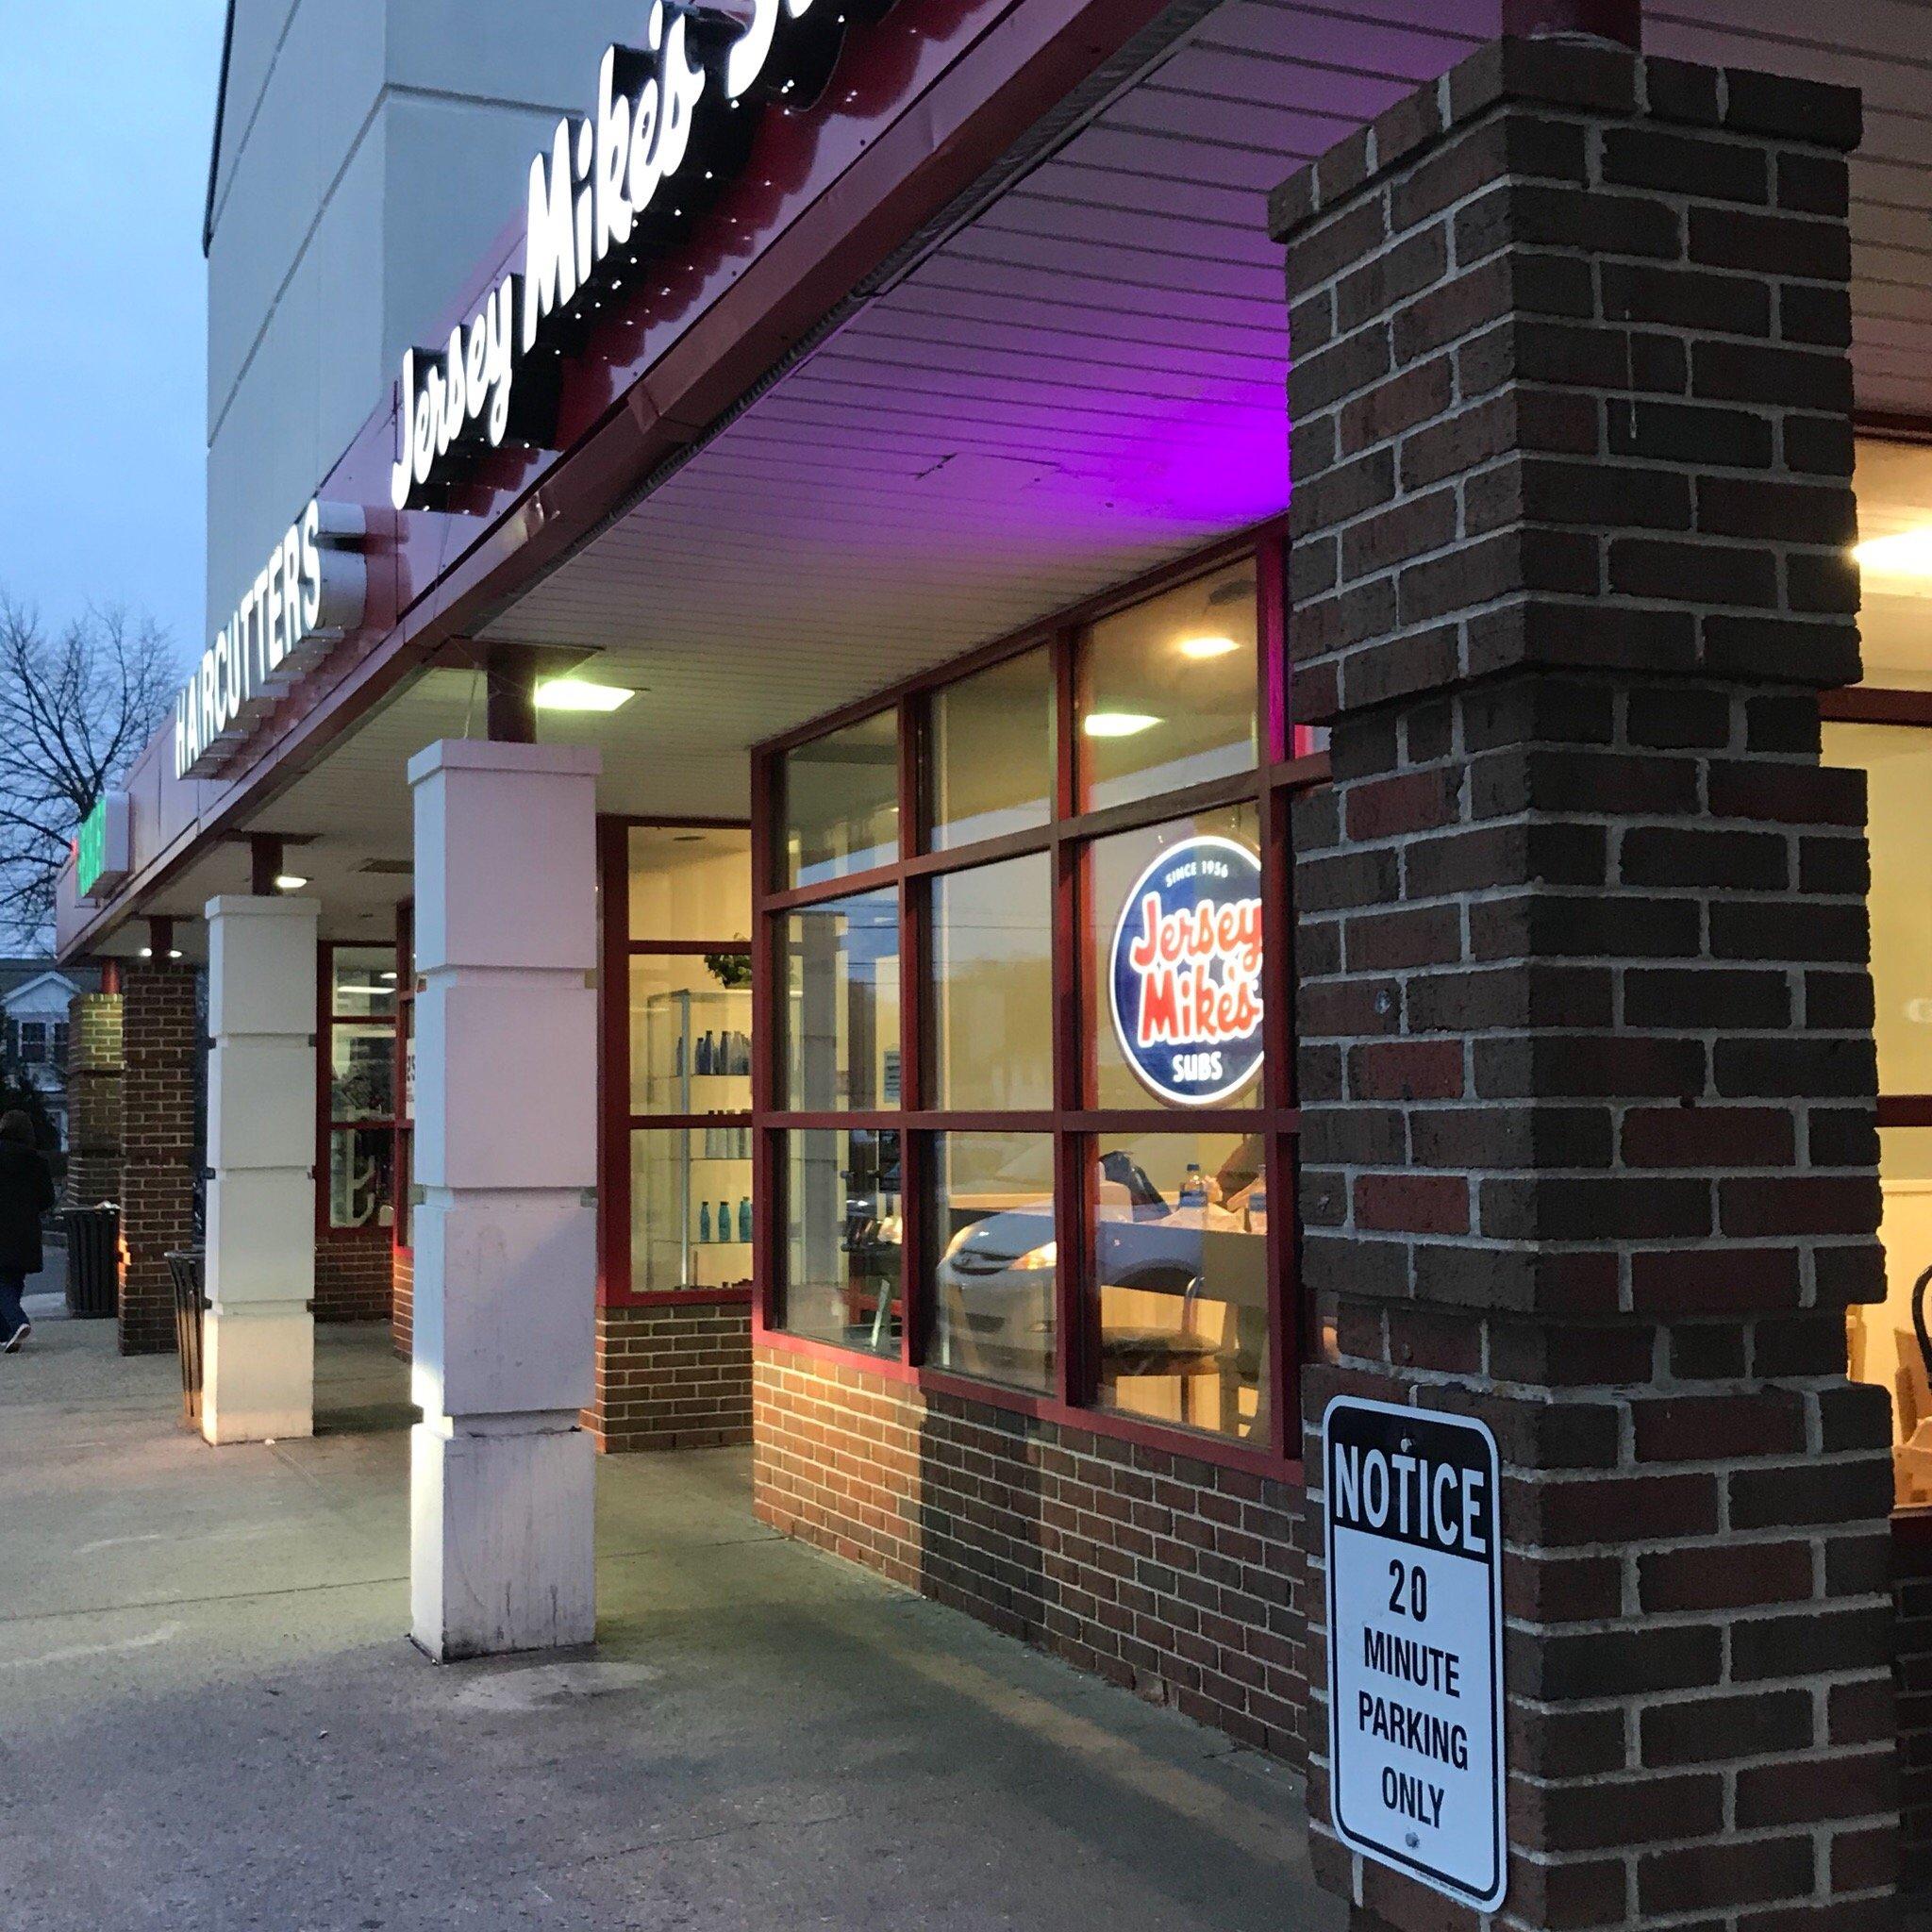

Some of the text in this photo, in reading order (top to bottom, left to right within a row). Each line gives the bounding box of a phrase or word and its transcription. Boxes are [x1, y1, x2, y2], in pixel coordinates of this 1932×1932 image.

[391, 274, 513, 510] Jersey
[175, 499, 321, 780] HAIRCUTTERS
[1165, 859, 1229, 888] SINCE 1956
[1132, 892, 1262, 977] Jersey
[1173, 1050, 1224, 1082] SUBS
[1335, 1441, 1487, 1554] NOTICE
[1389, 1558, 1428, 1623] 20
[1364, 1627, 1460, 1698] MINUTE
[1358, 1690, 1468, 1771] PARKING
[1382, 1765, 1444, 1829] ONLY
